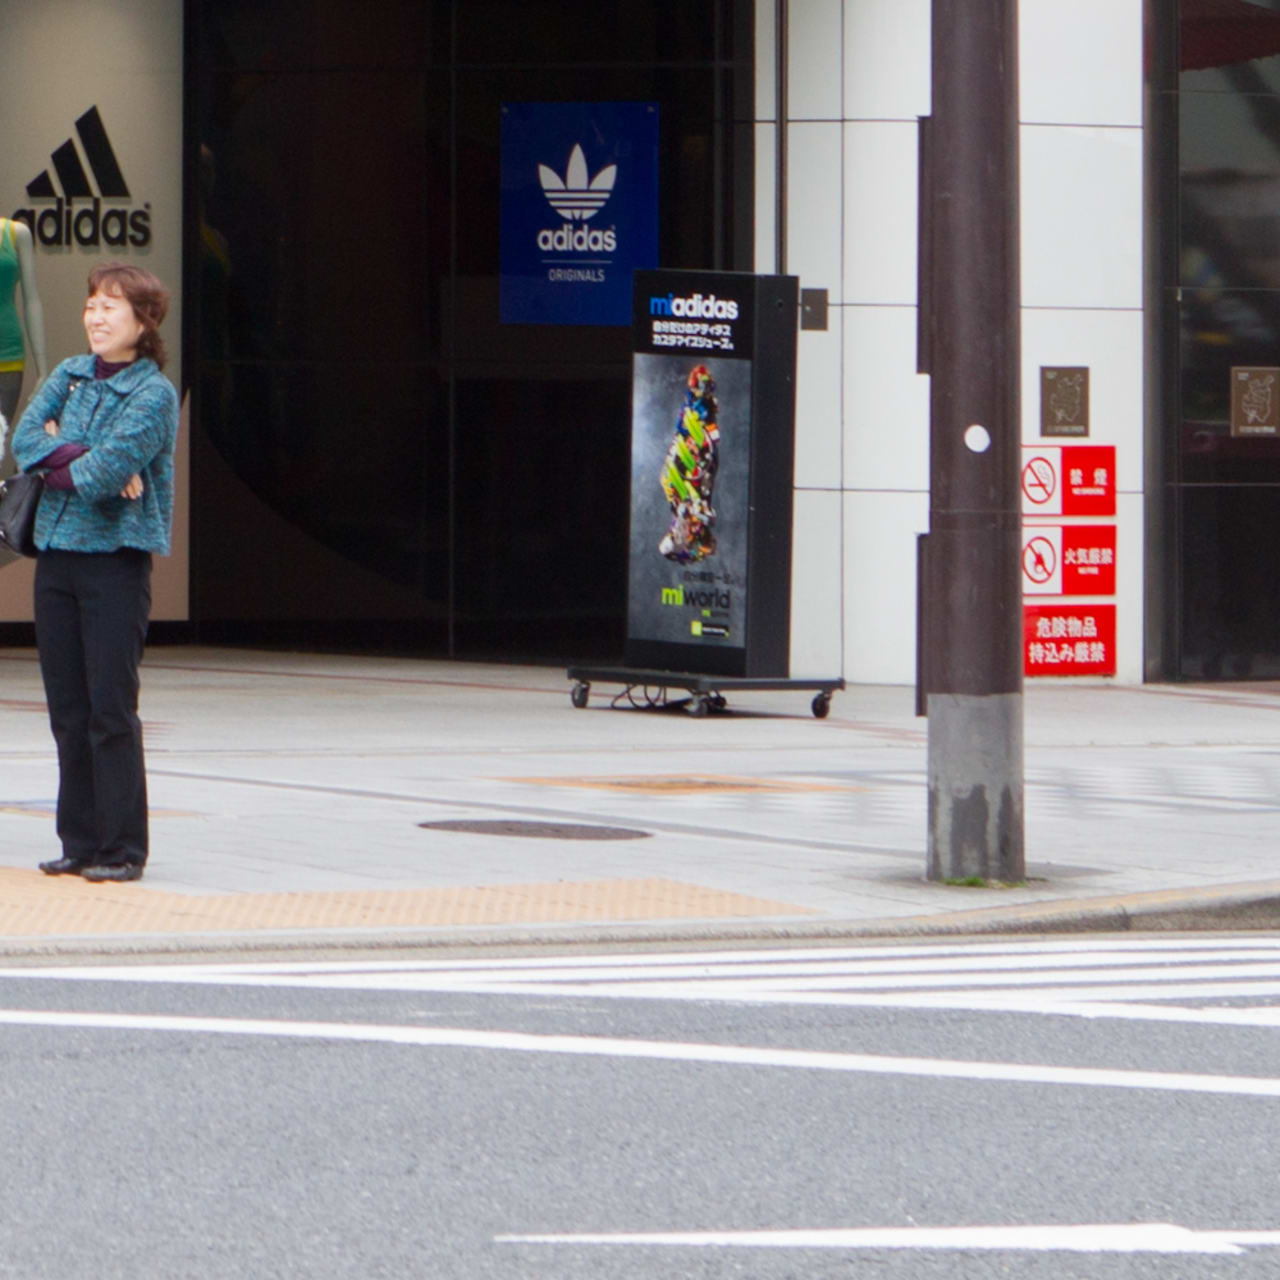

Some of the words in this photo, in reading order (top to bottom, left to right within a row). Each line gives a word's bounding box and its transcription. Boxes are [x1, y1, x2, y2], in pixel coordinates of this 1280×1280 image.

[537, 223, 617, 252] adidas
[548, 268, 606, 283] ORIGINALS
[1029, 642, 1105, 664] 持込み厳禁
